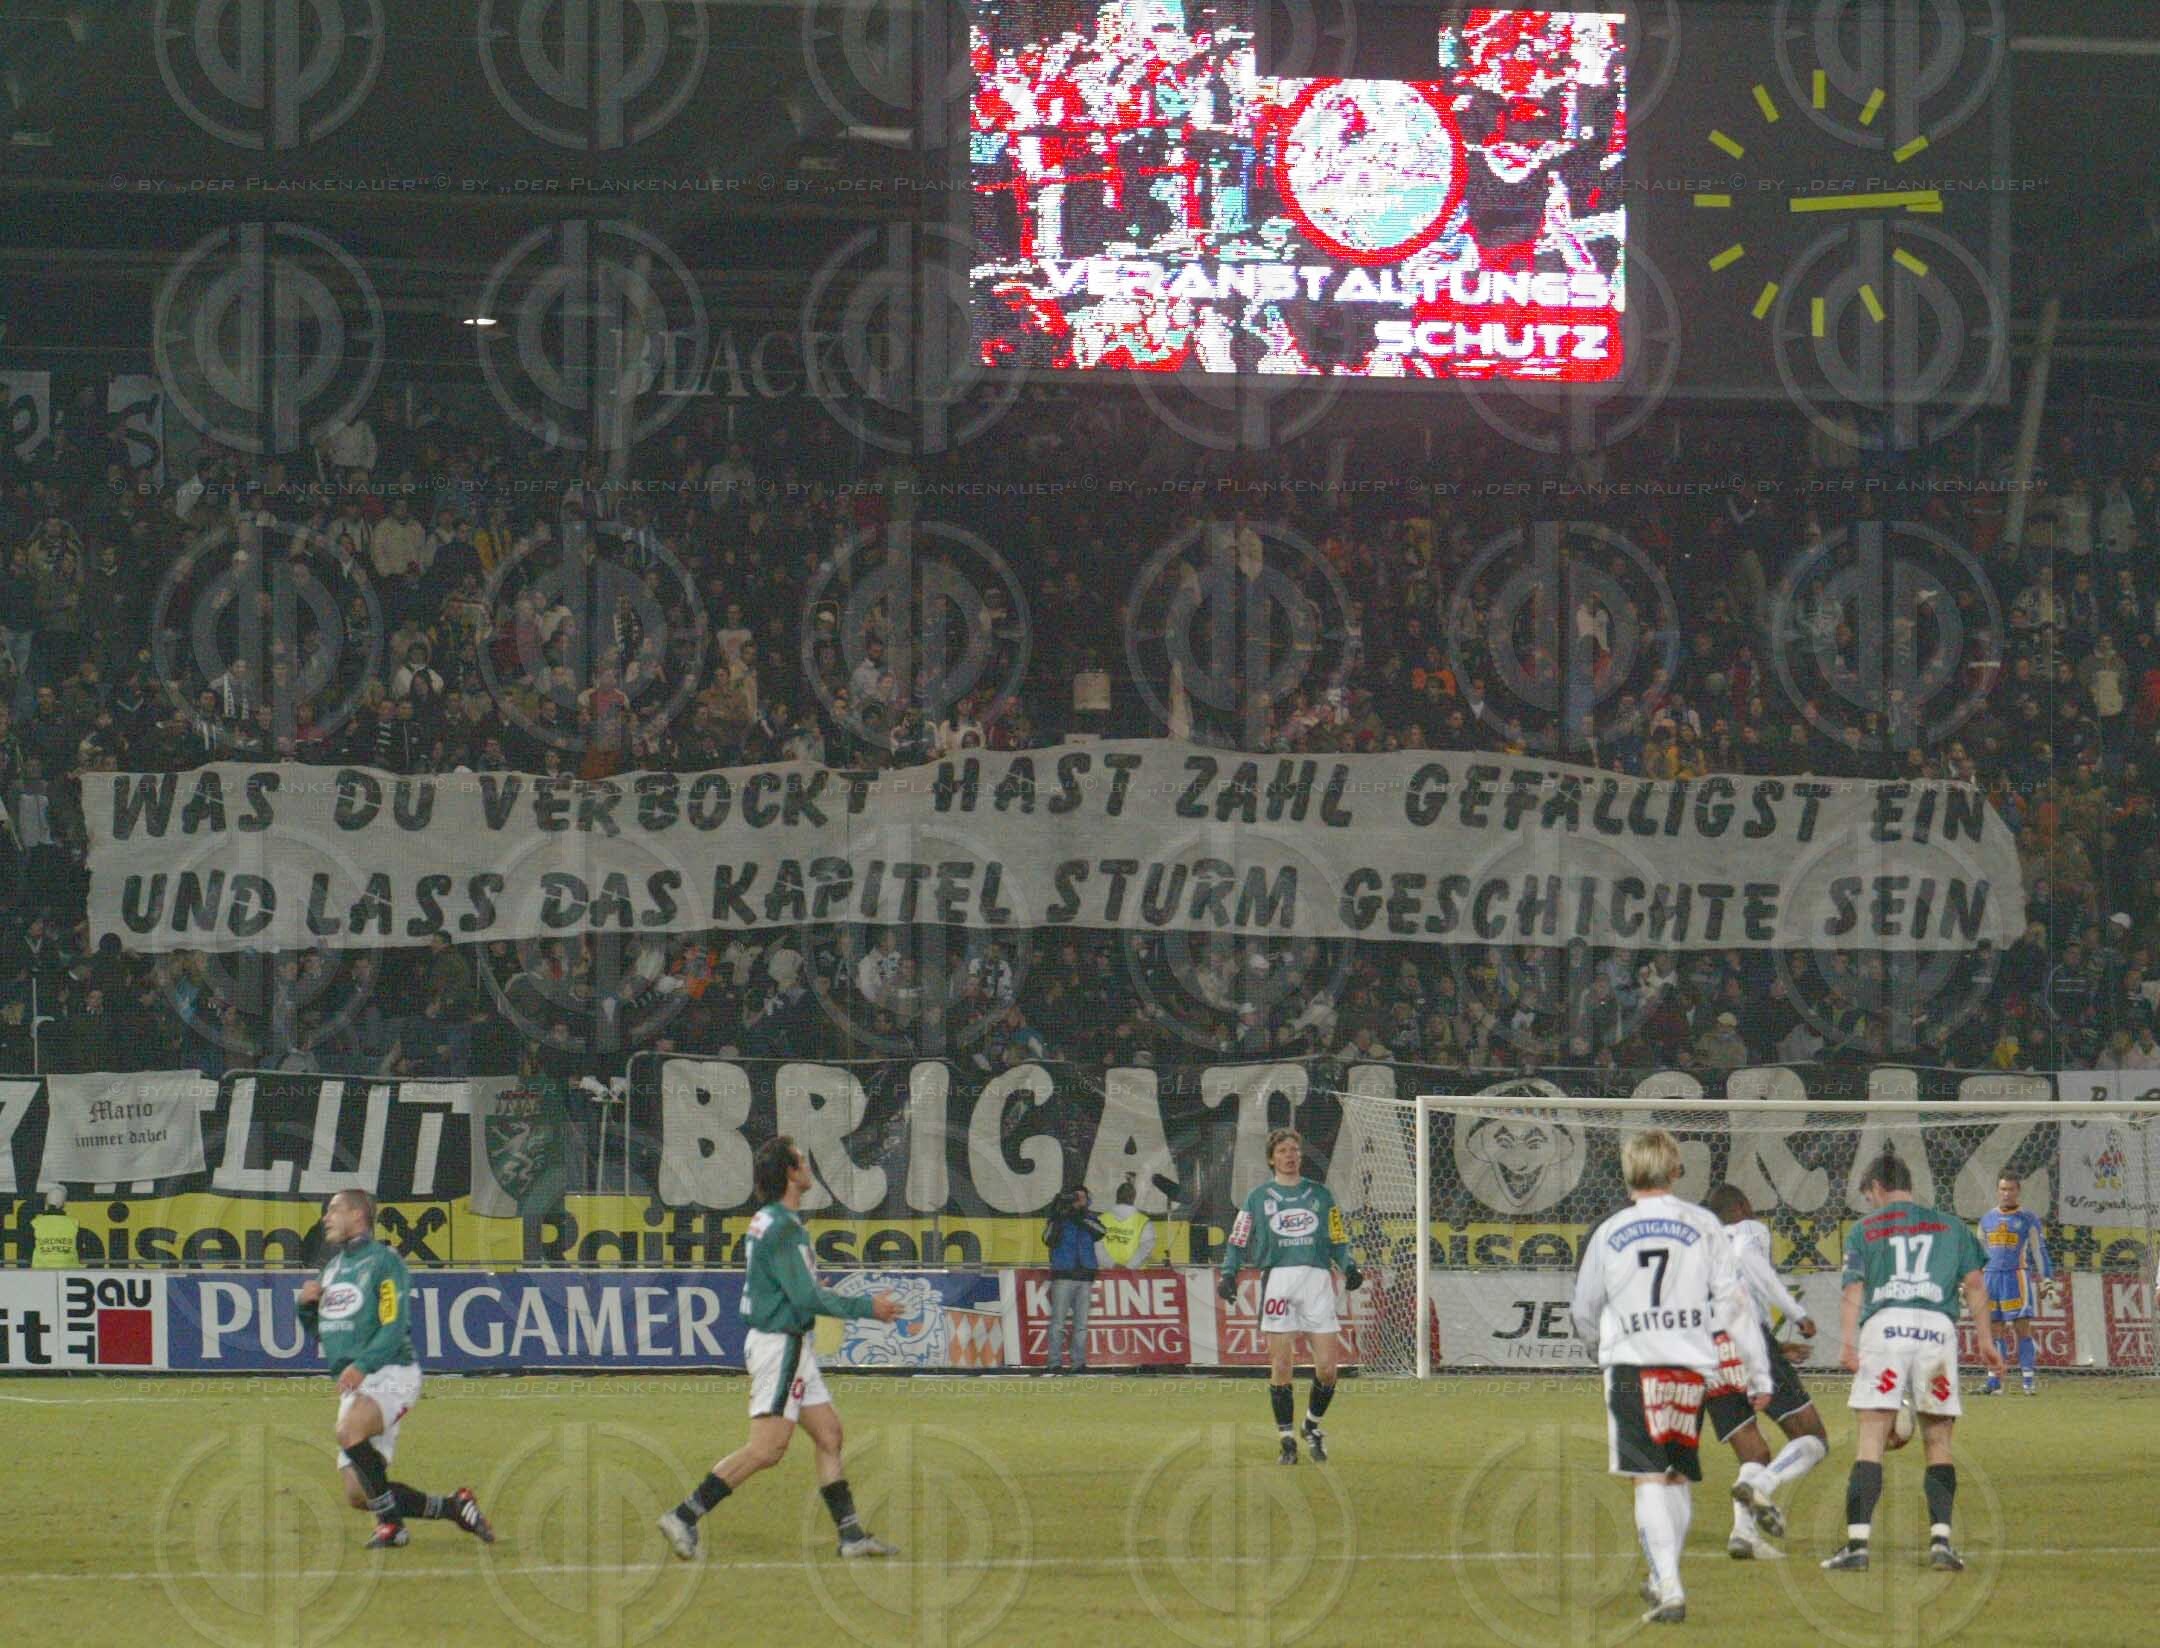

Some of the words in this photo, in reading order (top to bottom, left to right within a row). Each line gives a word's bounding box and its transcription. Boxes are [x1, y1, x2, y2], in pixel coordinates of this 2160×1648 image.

[1042, 260, 1608, 307] VERANSTALTUNGS
[1375, 321, 1608, 360] SCHUTZ
[112, 772, 281, 840] WAS
[333, 768, 435, 832] DU
[478, 768, 879, 837] VERBOCKT
[933, 751, 1143, 818] HAST
[1175, 755, 1354, 829] ZAHL
[1403, 762, 1832, 843] GEFÄLLIGST
[1870, 781, 1991, 846] EIN
[121, 870, 278, 937] UND
[306, 872, 505, 937] LASS
[539, 870, 683, 928] DAS
[712, 856, 1012, 927] KAPITEL
[1046, 857, 1299, 929] STURM
[1340, 867, 1782, 943] GESCHICHTE
[1823, 875, 1991, 943] SEIN
[89, 1100, 153, 1123] Mario
[521, 1206, 981, 1268] Raiffsen
[1609, 1220, 1699, 1251] PUNTIGAMER
[1888, 1234, 1934, 1281] 17
[1025, 1278, 1180, 1316] KEINE
[1638, 1248, 1669, 1307] 7
[198, 1281, 725, 1359] PUIGAMER
[1027, 1327, 1183, 1355] ZTUNG
[1883, 1326, 1945, 1344] SUZUKI
